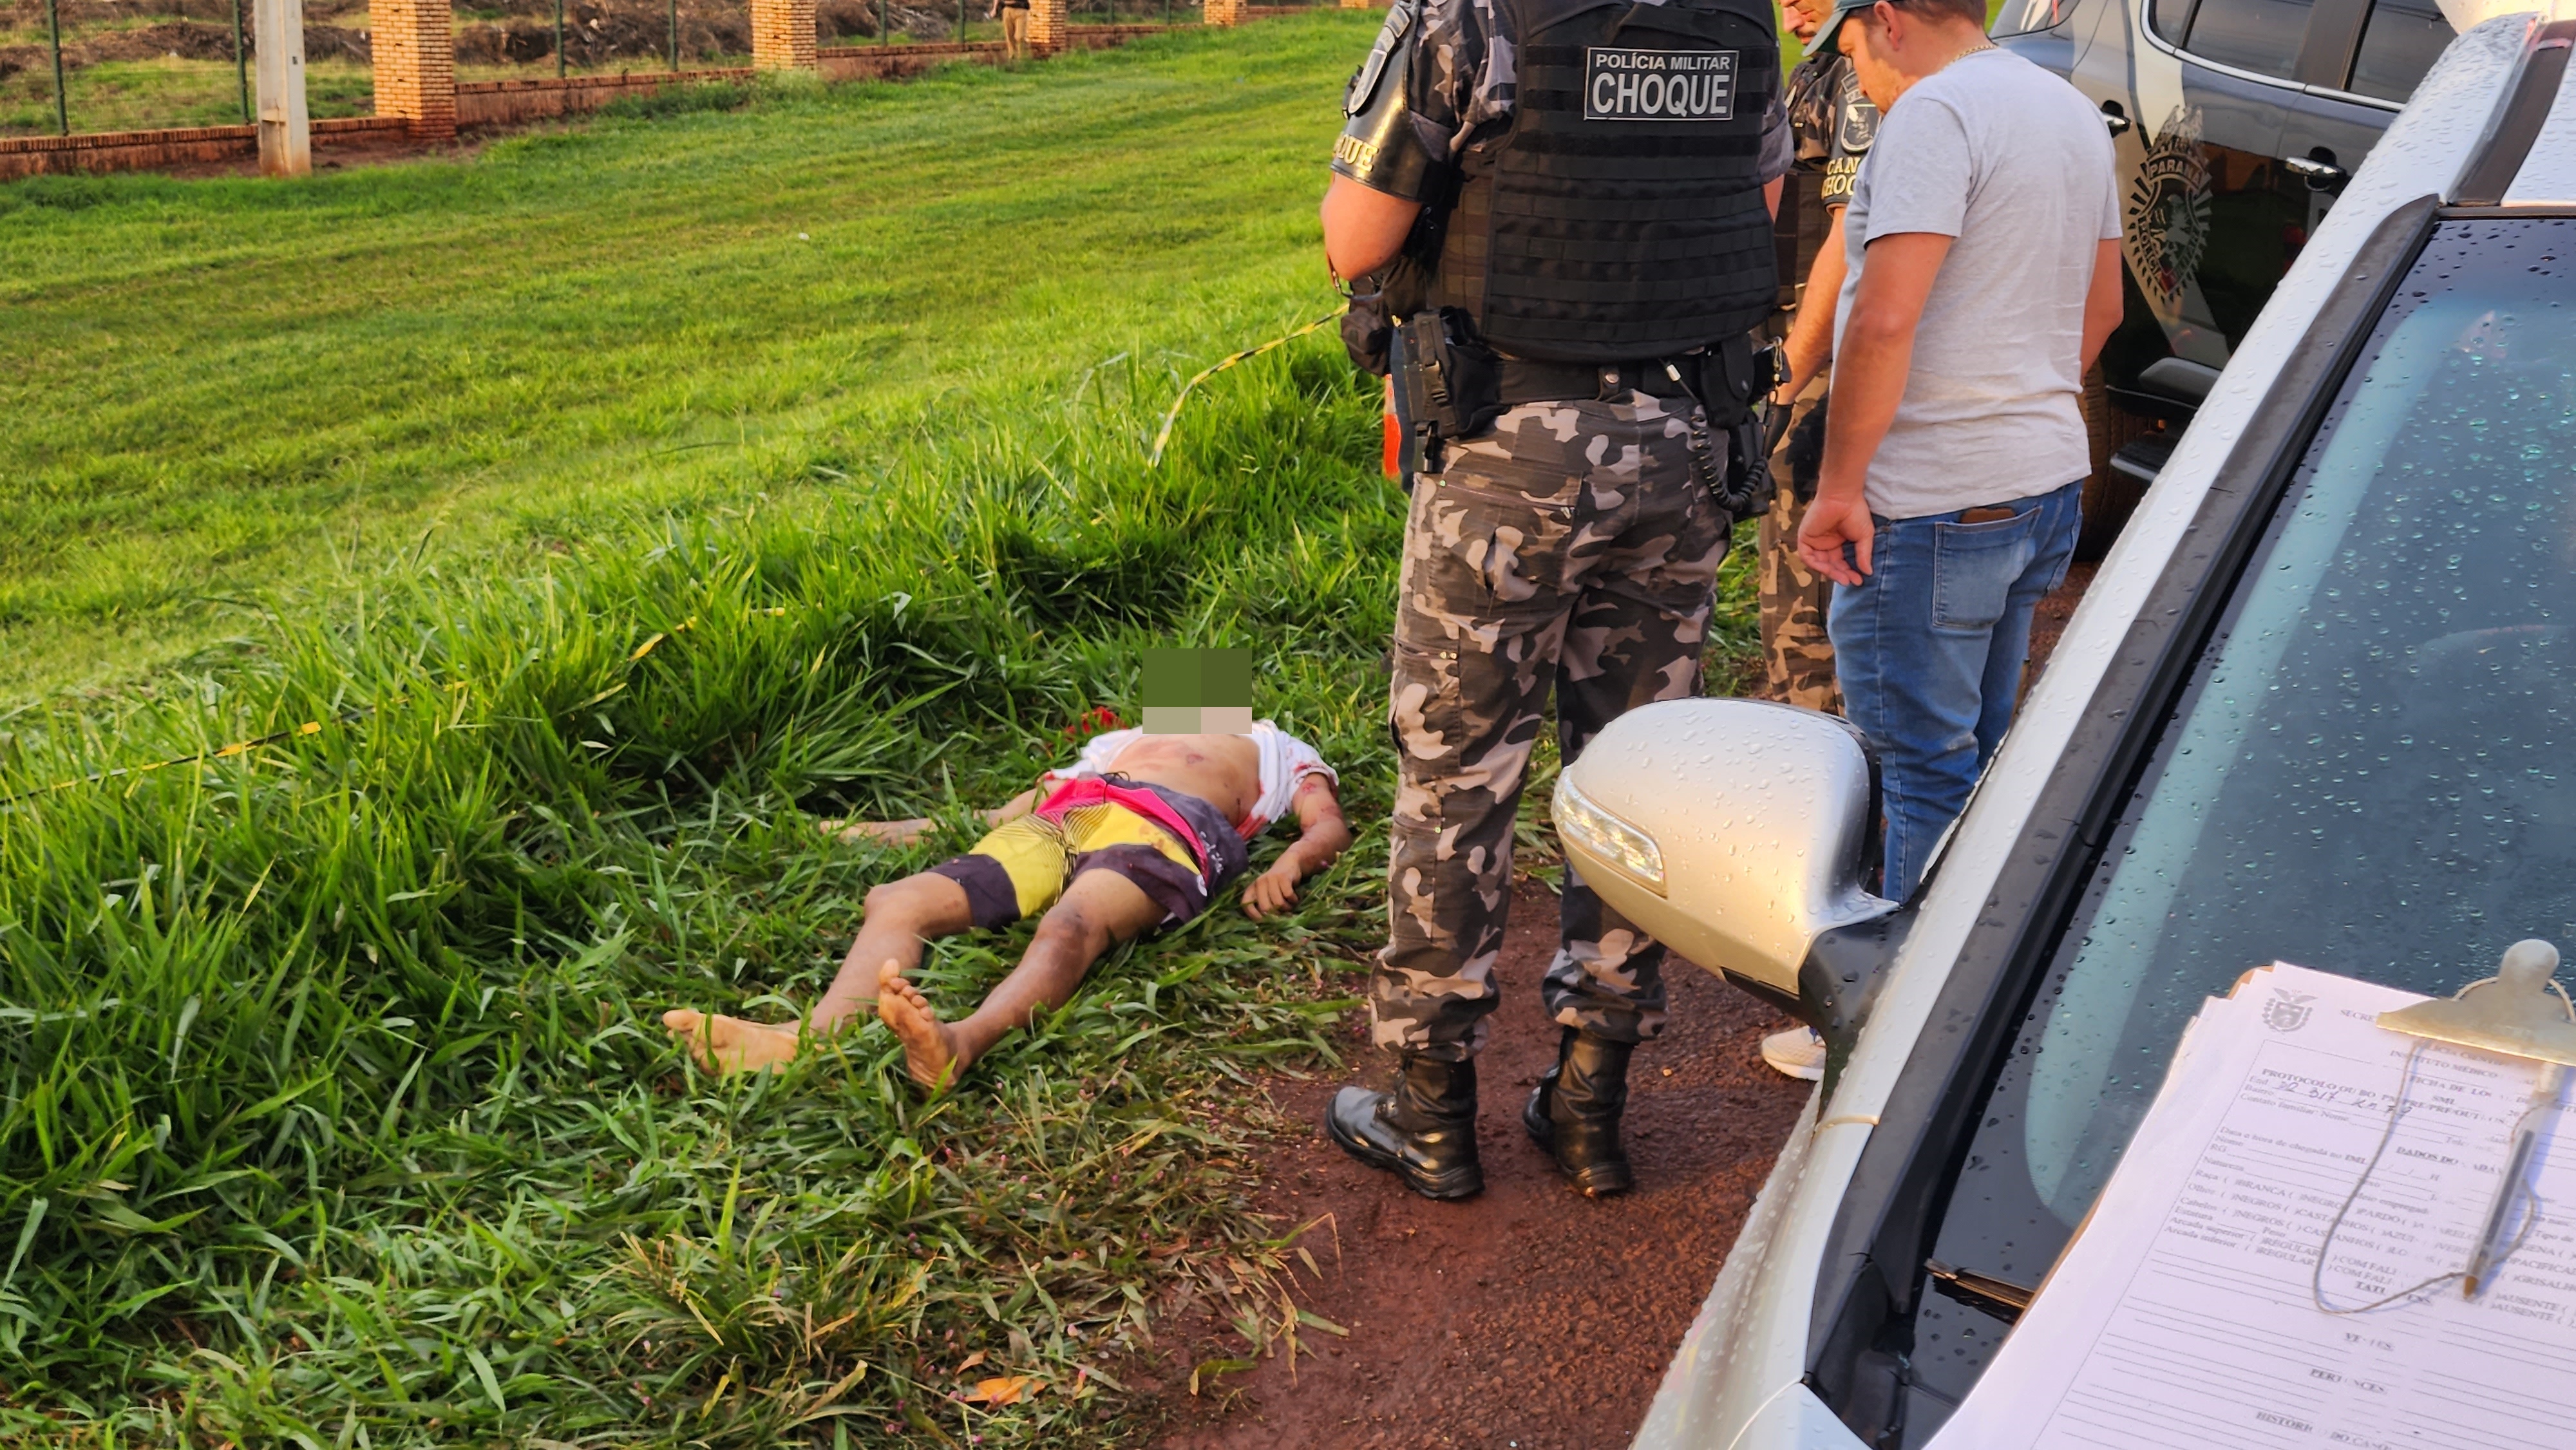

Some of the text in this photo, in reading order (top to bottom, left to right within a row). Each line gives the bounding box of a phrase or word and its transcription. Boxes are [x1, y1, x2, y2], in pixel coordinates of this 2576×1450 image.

[1596, 52, 1730, 70] POLÍCIA MILITAR
[1592, 72, 1730, 117] CHOQUE
[1827, 156, 1861, 175] CAN
[2261, 1068, 2336, 1091] PROTOCOLO
[2240, 1093, 2277, 1106] Contato
